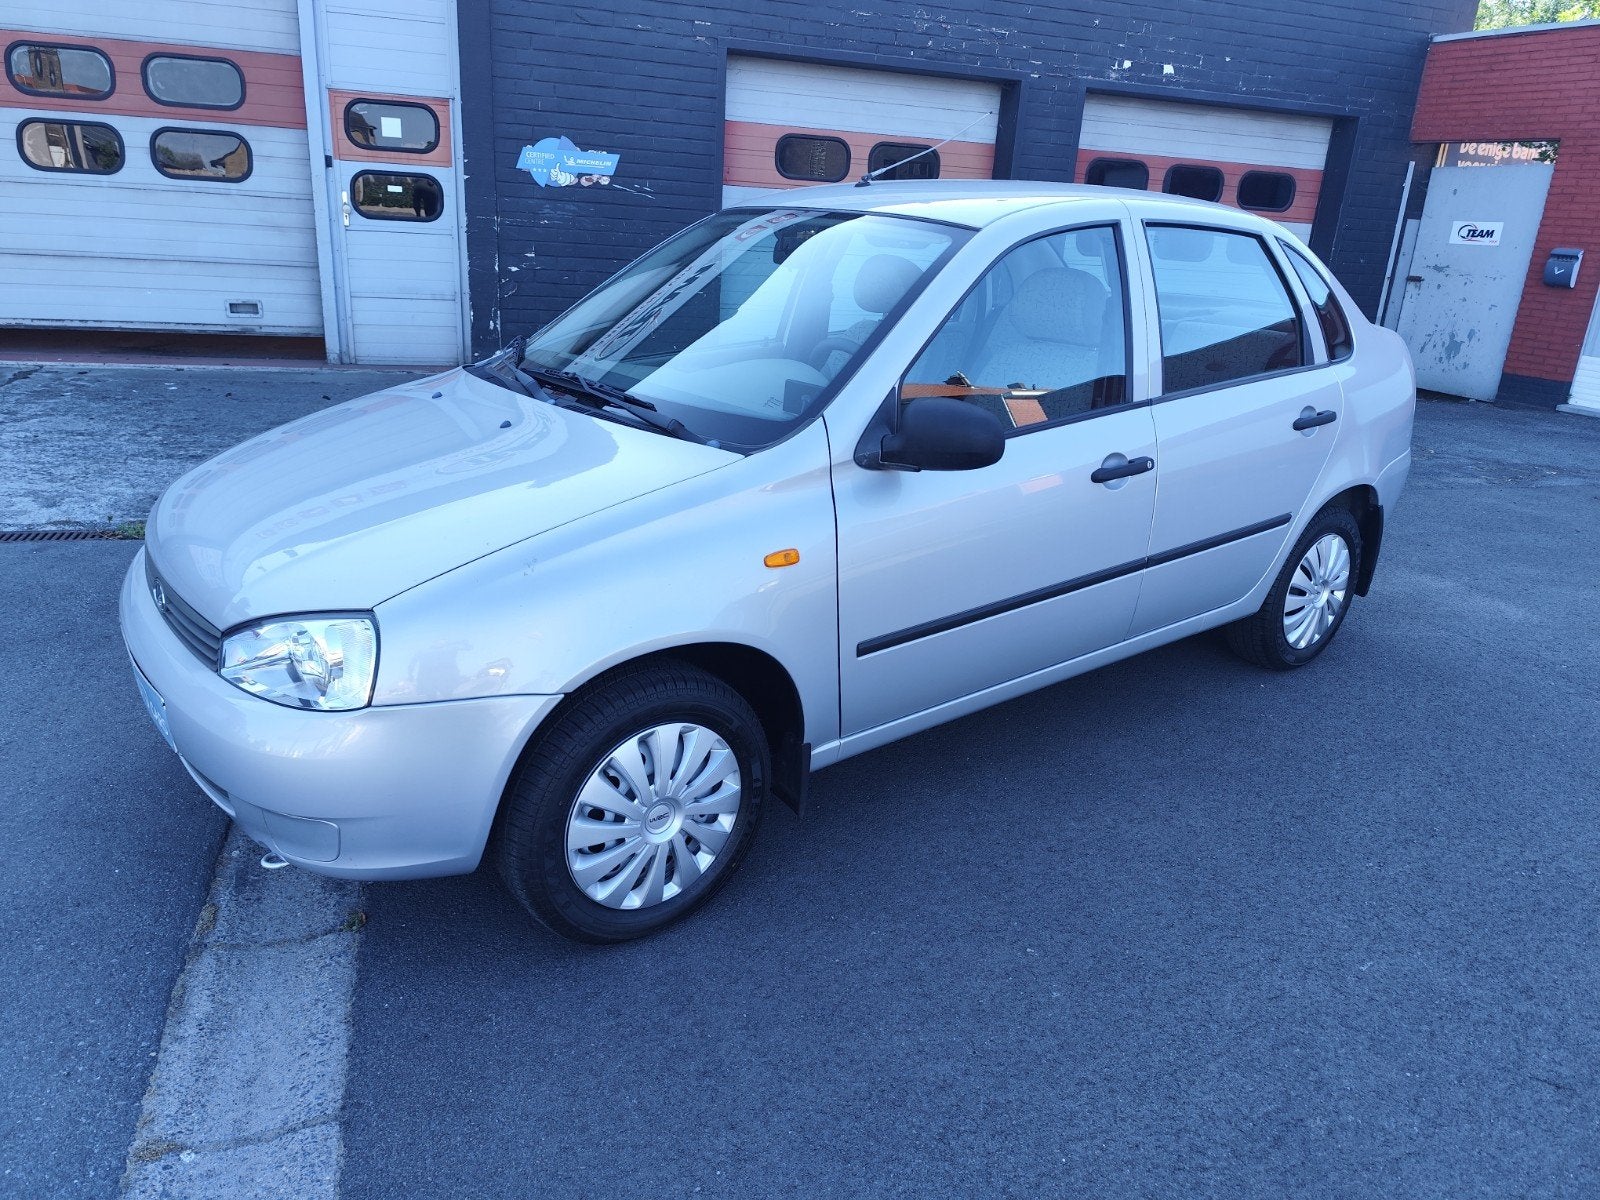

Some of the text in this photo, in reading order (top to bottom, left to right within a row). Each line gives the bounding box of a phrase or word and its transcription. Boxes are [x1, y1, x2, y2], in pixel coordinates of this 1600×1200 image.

[525, 151, 555, 159] CERTIFIED
[1512, 142, 1540, 160] ban
[576, 158, 612, 167] MICHELIN
[1466, 229, 1495, 239] TEAM
